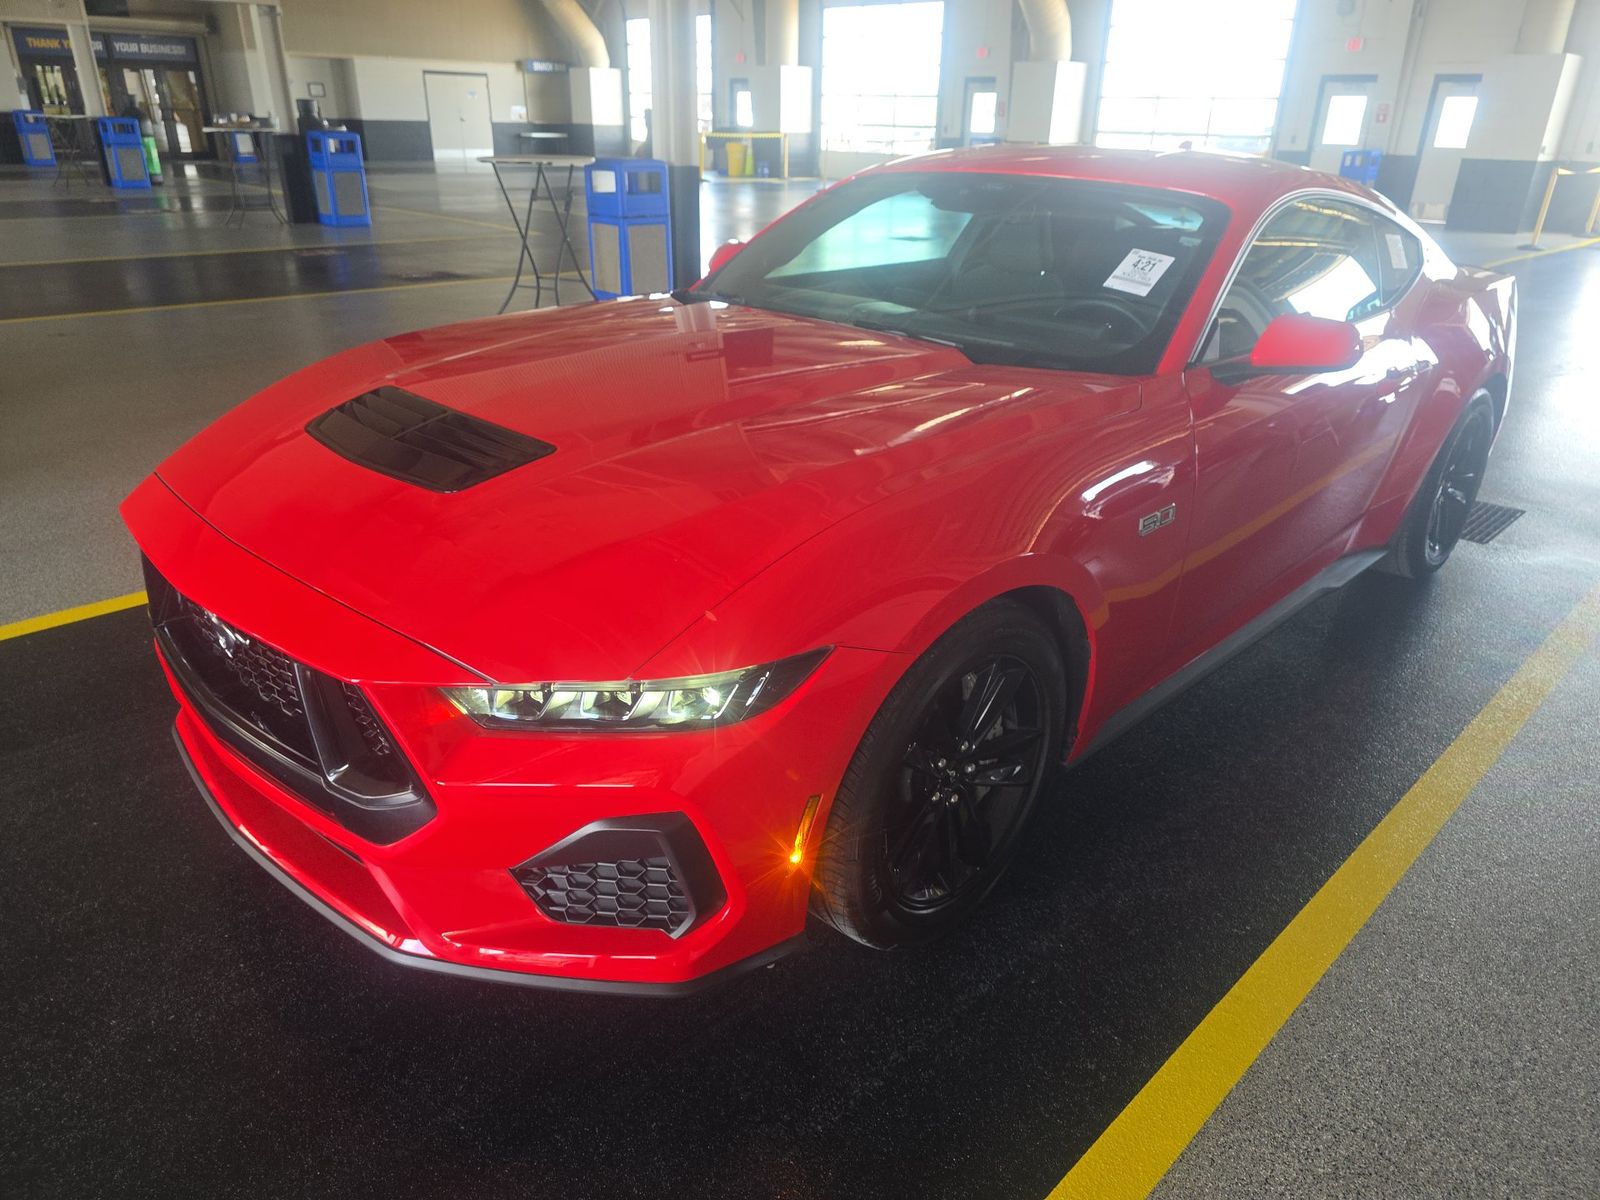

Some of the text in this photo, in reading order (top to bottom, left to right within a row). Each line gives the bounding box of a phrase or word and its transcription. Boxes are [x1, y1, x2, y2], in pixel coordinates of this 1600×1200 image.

[26, 37, 61, 49] THANK
[113, 42, 139, 53] YOUR
[1139, 503, 1175, 537] 5.0
